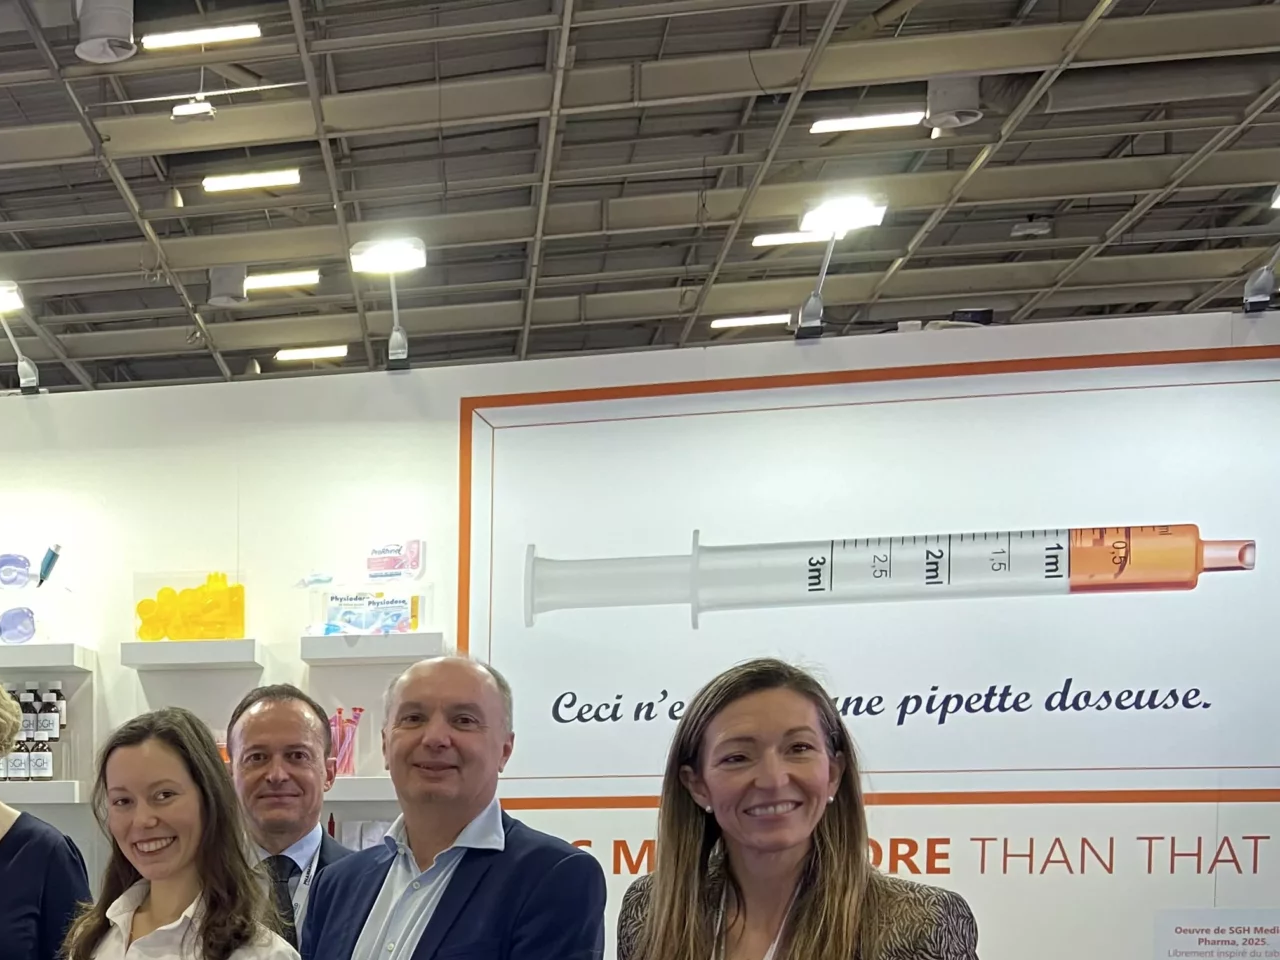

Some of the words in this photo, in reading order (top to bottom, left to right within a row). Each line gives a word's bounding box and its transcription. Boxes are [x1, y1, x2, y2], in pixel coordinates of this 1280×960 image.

[807, 556, 826, 592] 3ml
[871, 554, 888, 579] 2,5
[925, 549, 944, 586] 2ml
[989, 548, 1007, 572] 1,5
[1044, 543, 1064, 579] 1ml
[551, 691, 624, 724] Ceci
[633, 688, 685, 721] n'e
[896, 684, 1033, 727] pipette
[1044, 678, 1212, 713] doseuse.
[970, 836, 1115, 875] THAN
[1136, 835, 1271, 875] THAT
[1174, 926, 1211, 935] Oeuvre
[1213, 926, 1226, 935] de
[1228, 926, 1251, 935] SGH
[1197, 937, 1239, 947] Pharma,
[1167, 949, 1214, 958] Librement
[1249, 949, 1262, 958] du
